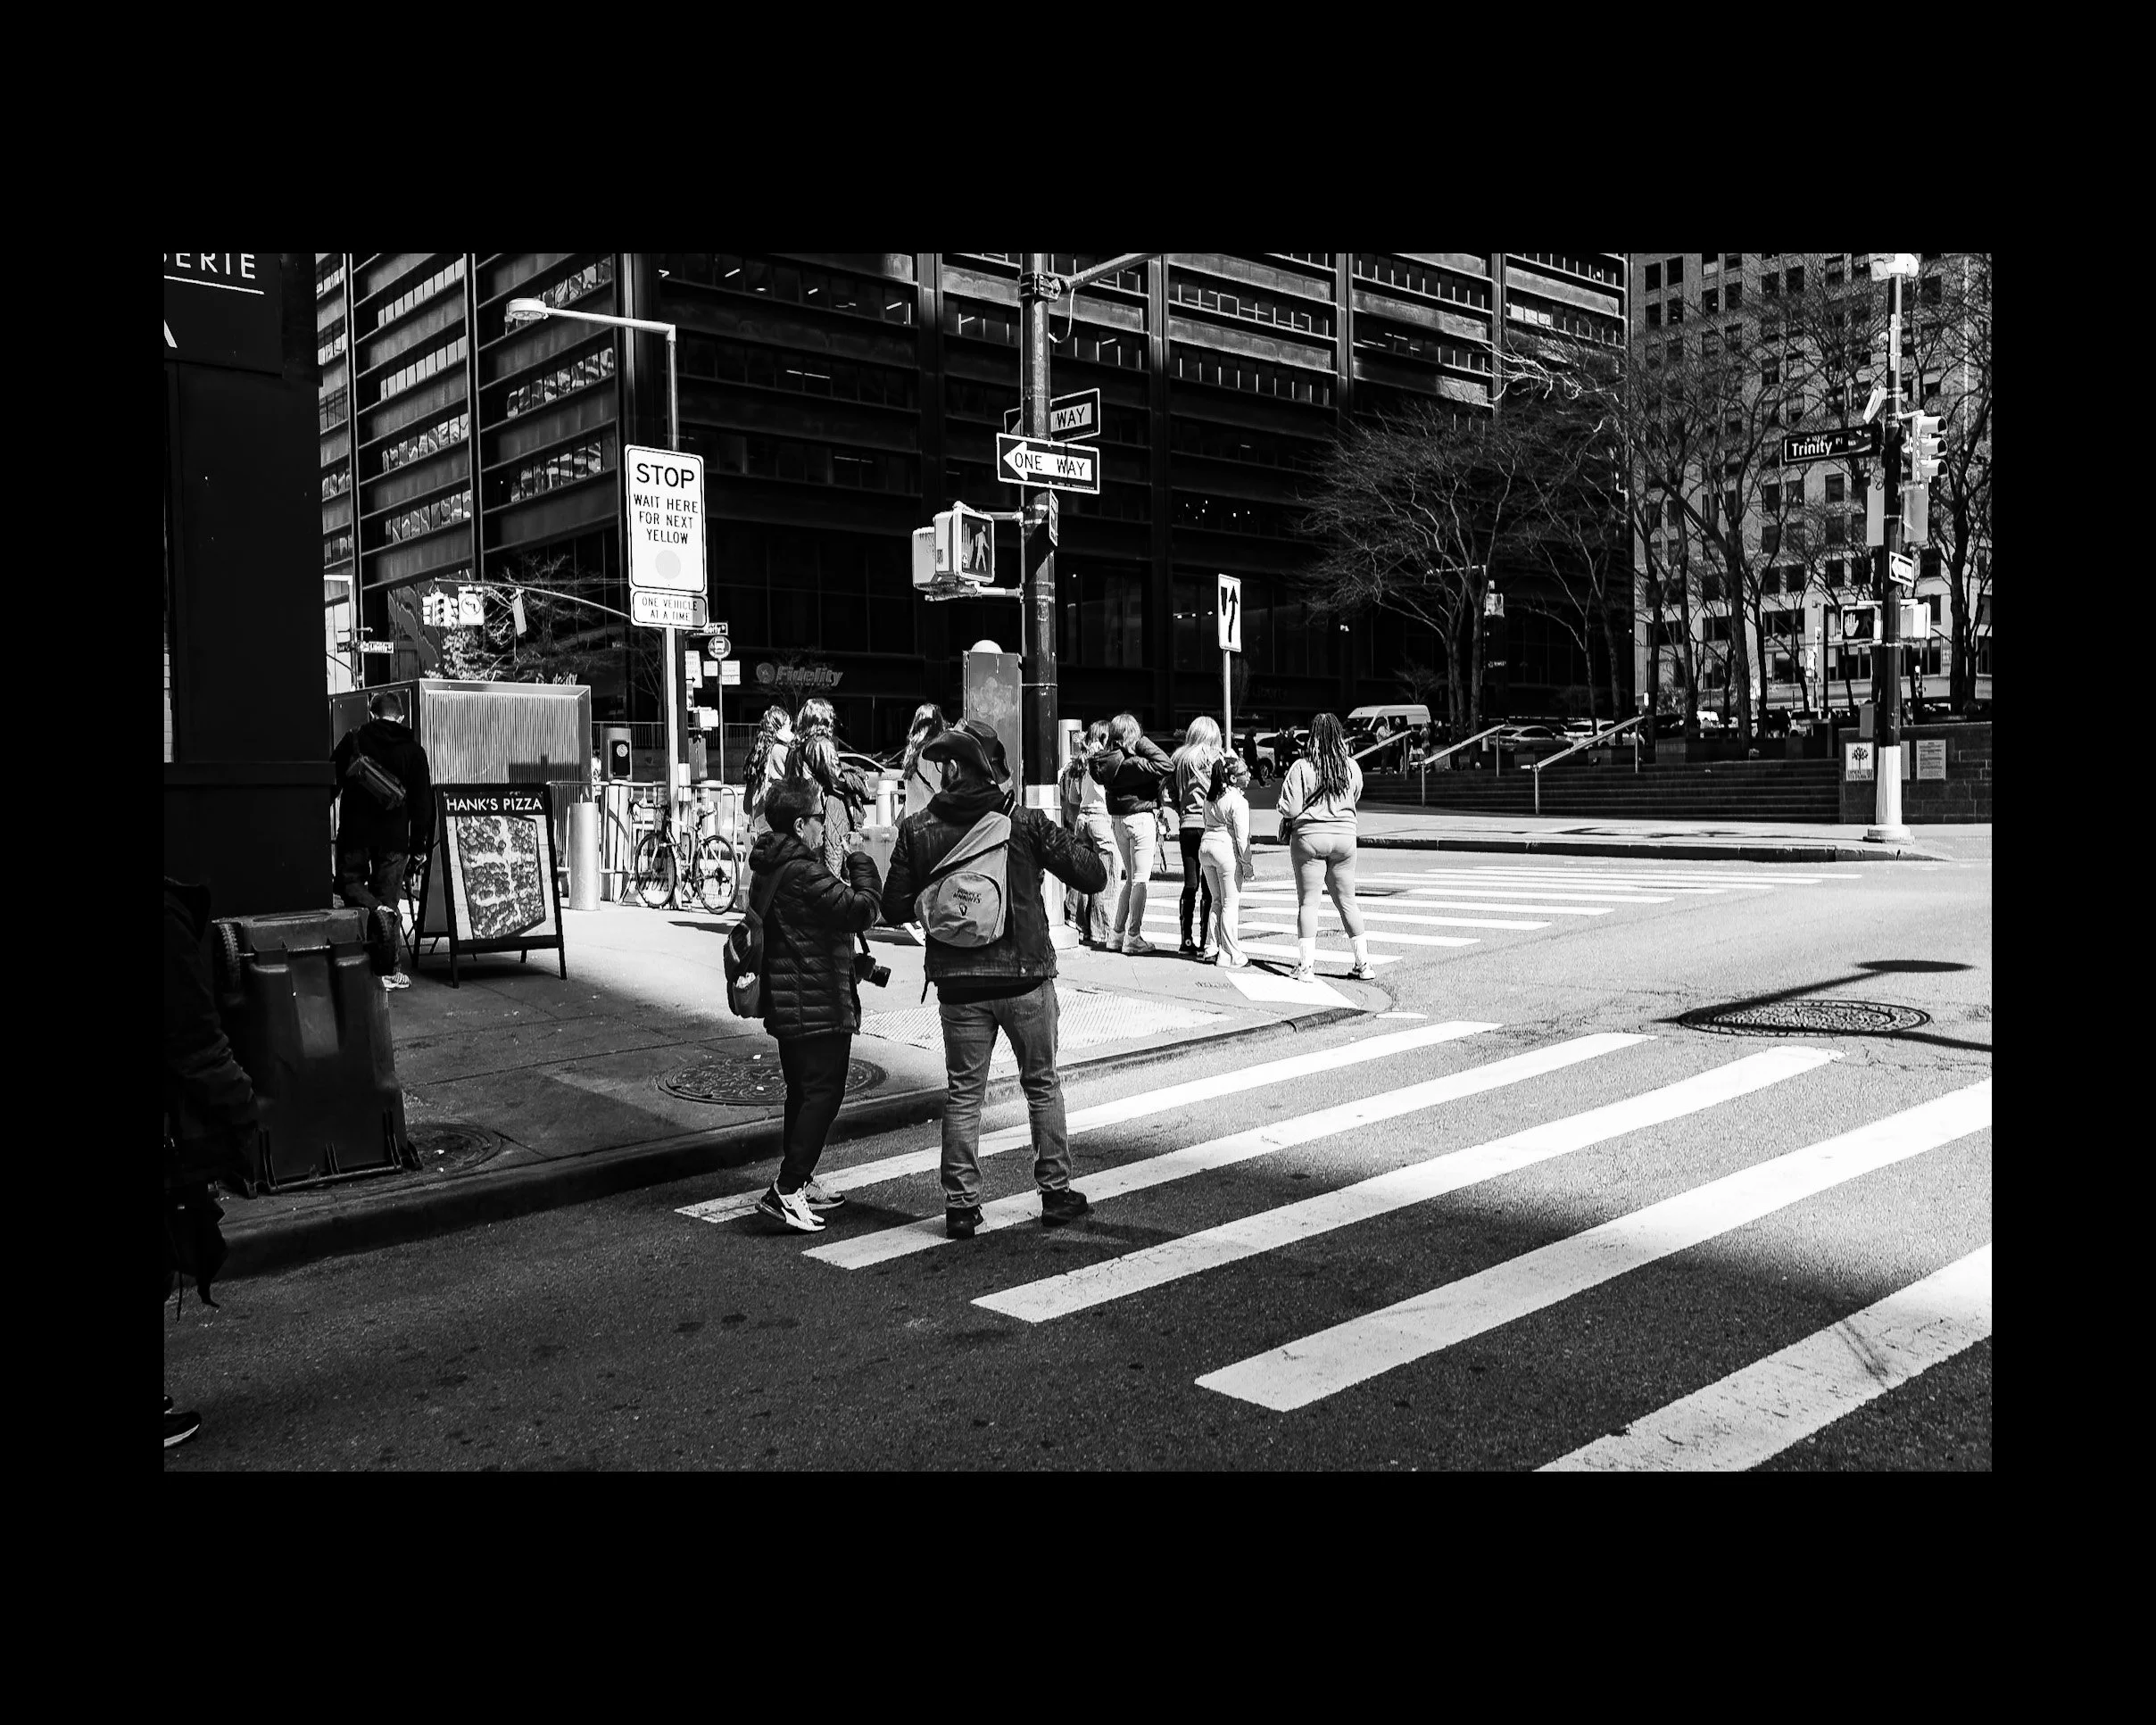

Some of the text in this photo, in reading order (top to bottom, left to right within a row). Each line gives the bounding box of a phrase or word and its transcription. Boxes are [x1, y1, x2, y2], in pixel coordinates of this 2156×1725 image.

[164, 253, 256, 279] ERIE
[1057, 406, 1086, 429] WAY
[1791, 440, 1833, 457] Trinity
[1015, 452, 1086, 477] ONE WAY
[636, 462, 695, 489] STOP
[634, 493, 699, 514] WAIT HERE
[639, 510, 693, 529] FOR NEXT
[646, 528, 689, 544] YELLOW
[642, 596, 698, 611] ONE VEHICLE
[650, 610, 691, 622] AT A TIME
[775, 666, 843, 687] Fidelity
[446, 798, 543, 811] HANK'S PIZZA
